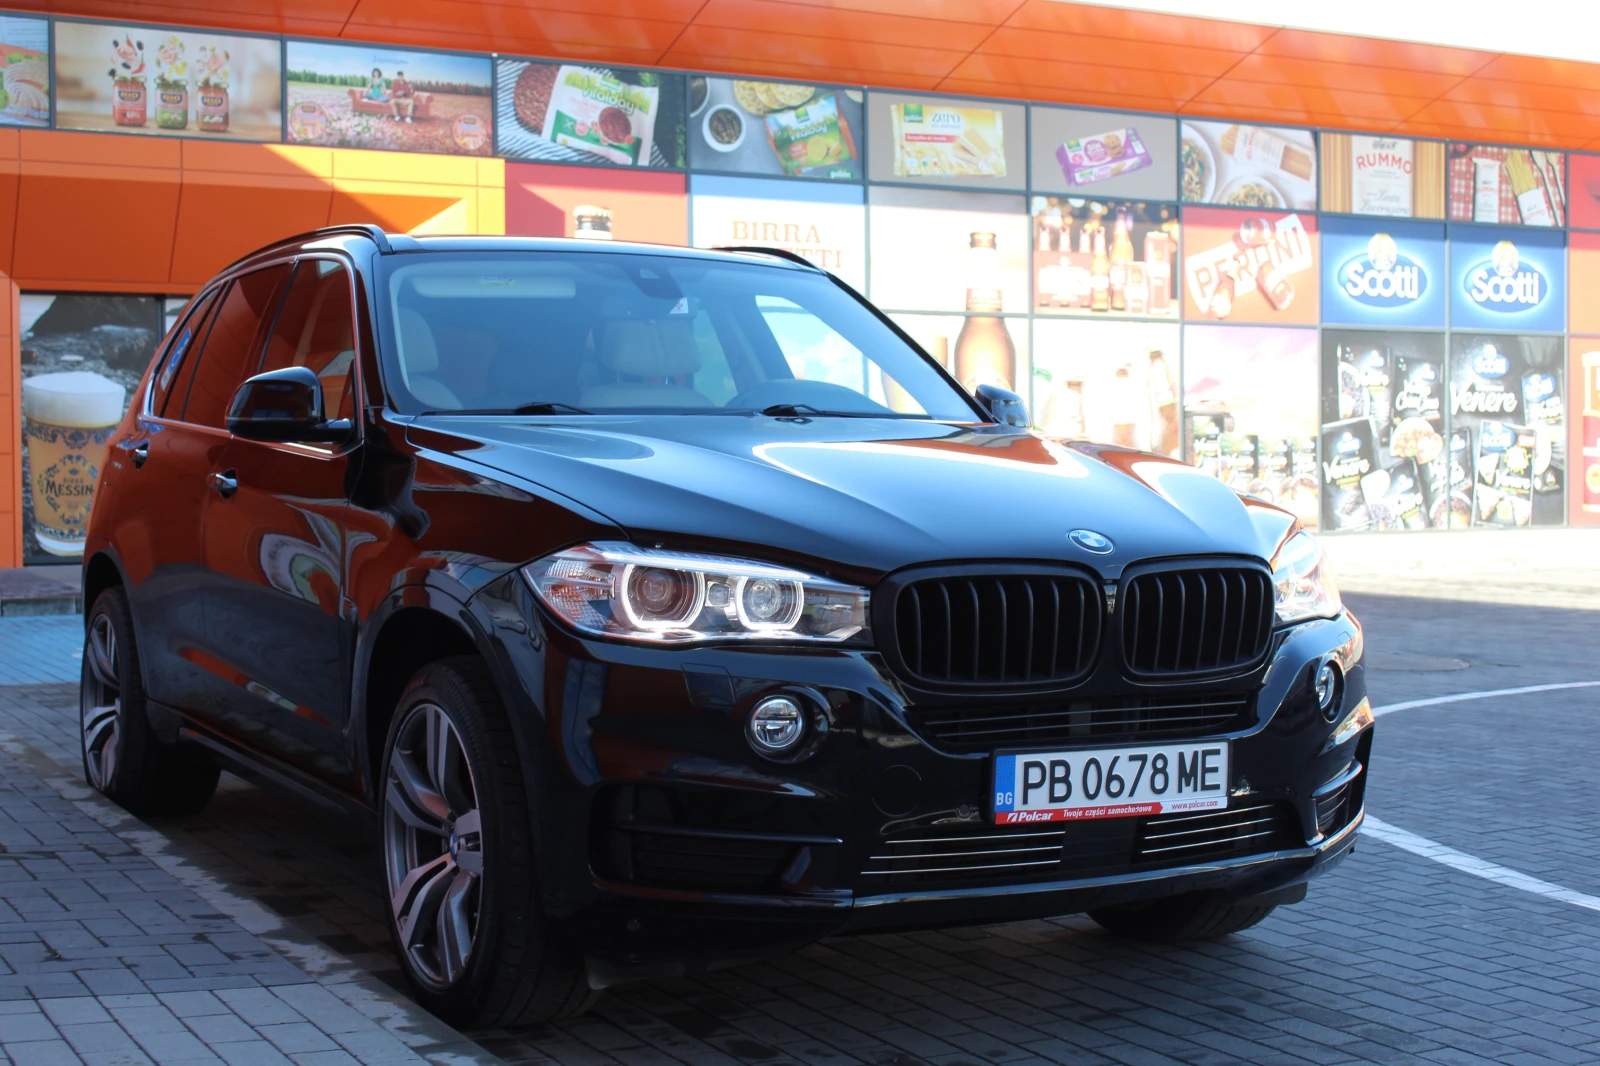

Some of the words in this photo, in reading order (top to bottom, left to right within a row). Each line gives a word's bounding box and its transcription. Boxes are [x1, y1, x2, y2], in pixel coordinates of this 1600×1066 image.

[1355, 152, 1413, 175] RUMMO
[732, 220, 822, 244] BIRRA
[1345, 262, 1419, 299] Scotti
[1471, 268, 1540, 305] Scotti
[1449, 379, 1518, 415] Venere
[44, 477, 94, 498] MESSIN
[1022, 759, 1072, 805] PB
[1082, 752, 1170, 800] 0678
[1177, 748, 1221, 793] ME
[996, 791, 1013, 806] BG
[1018, 811, 1053, 822] Polcar
[1063, 809, 1083, 819] Twoje
[1085, 807, 1106, 818] części
[1171, 799, 1219, 810] www.polcar.com
